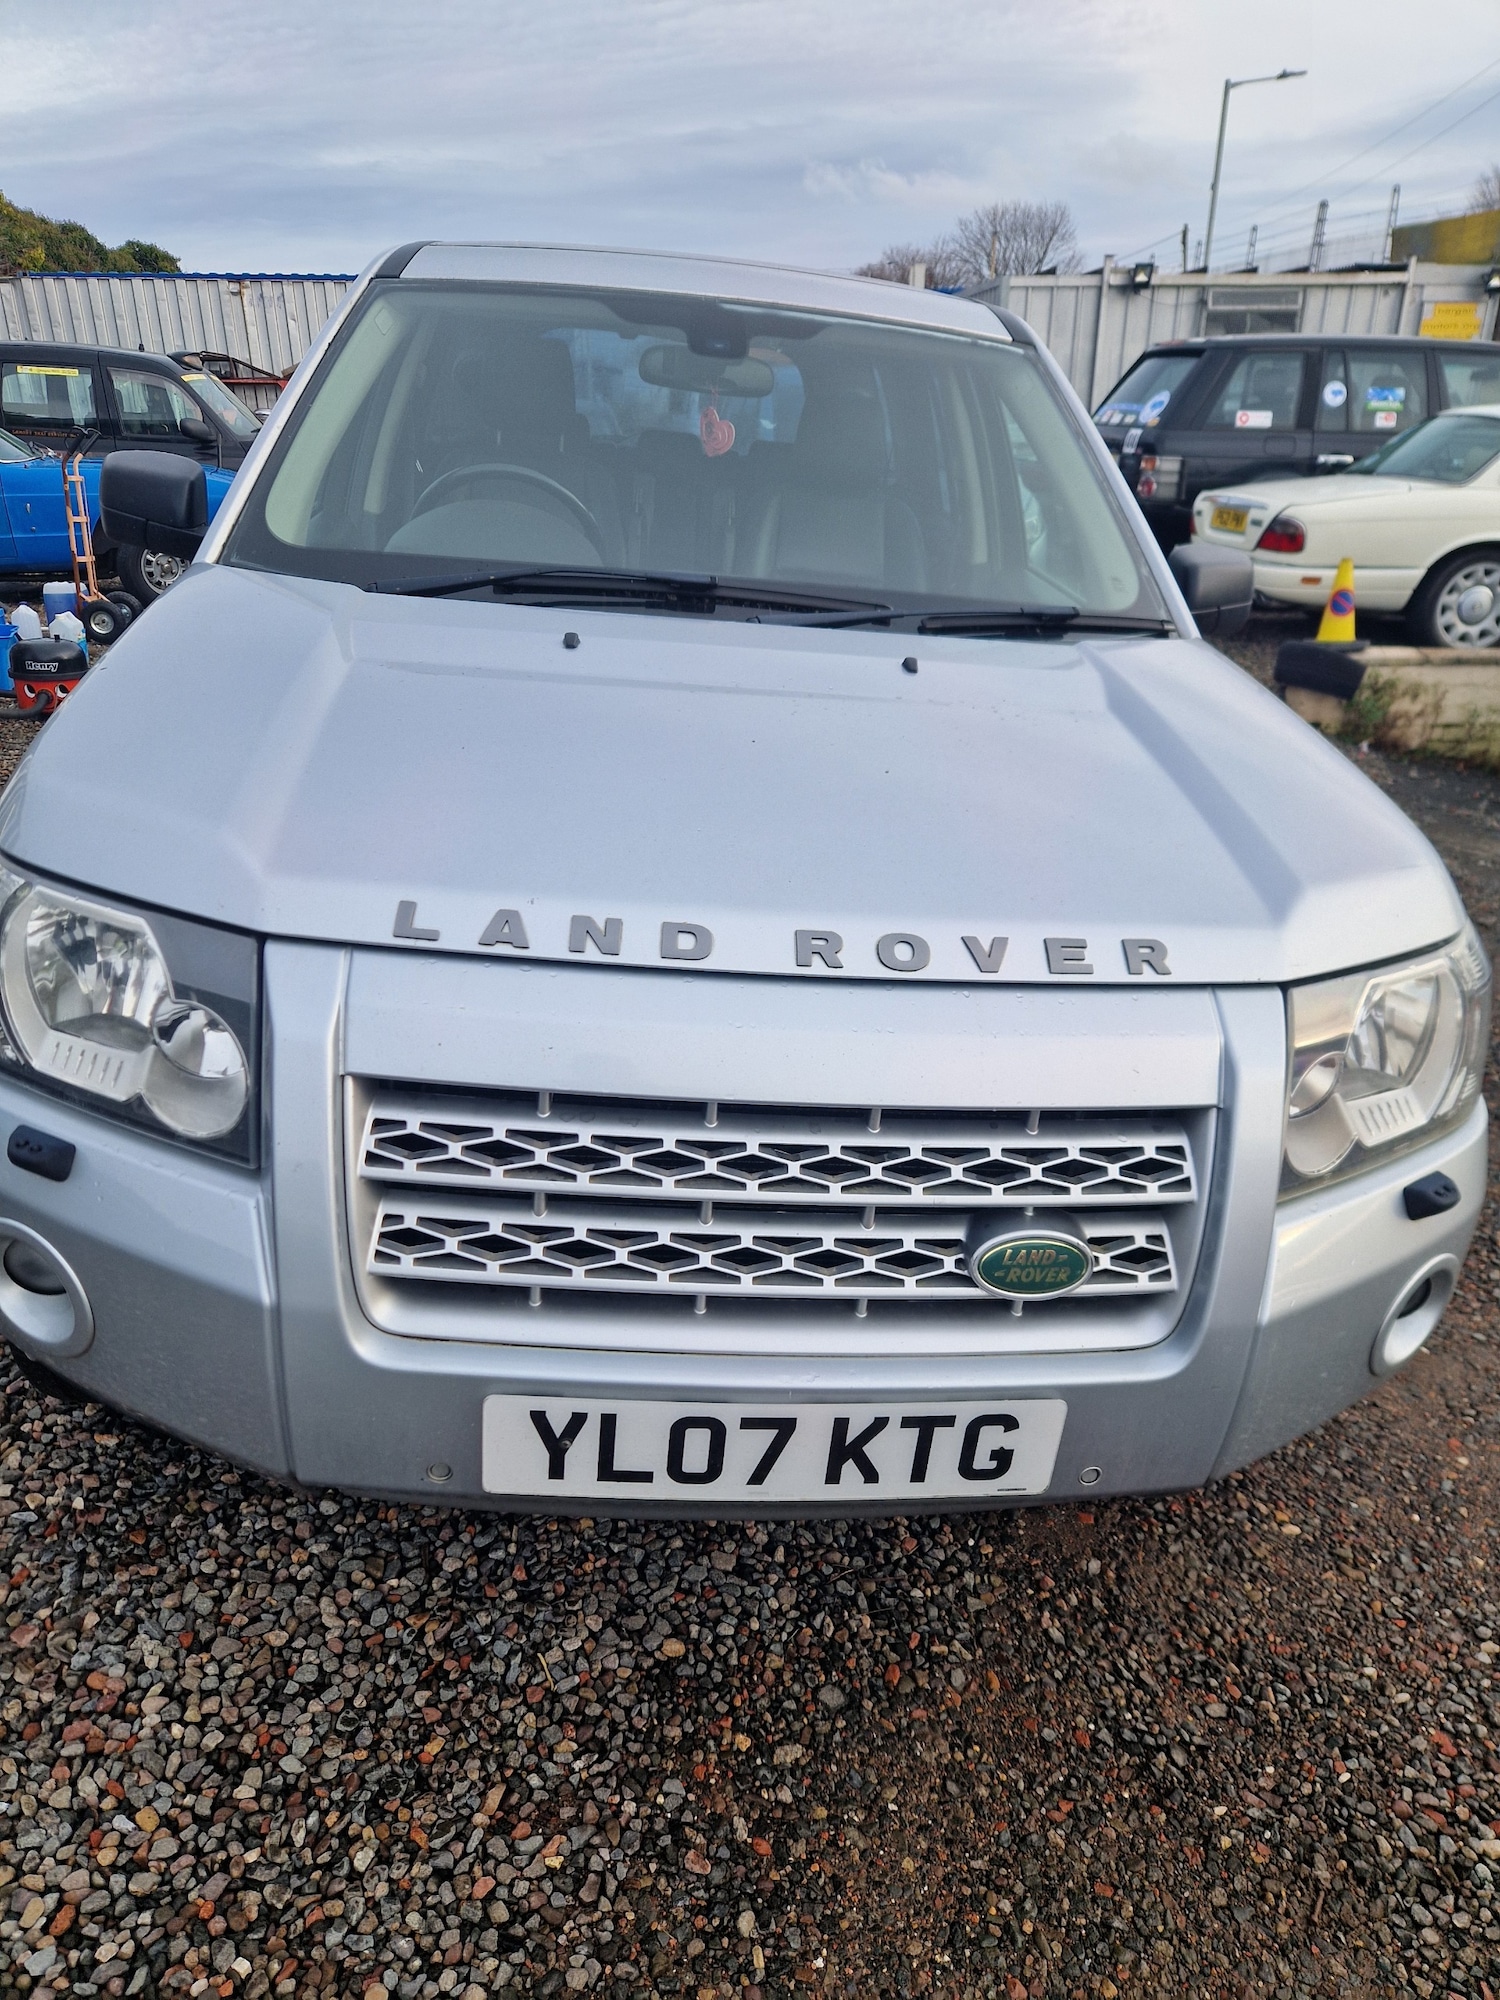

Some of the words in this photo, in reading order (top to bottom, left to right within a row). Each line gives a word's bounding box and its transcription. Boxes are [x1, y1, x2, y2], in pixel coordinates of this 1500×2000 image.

[25, 661, 59, 672] Henry
[393, 900, 714, 960] LAND
[794, 929, 1172, 975] ROVER
[1002, 1249, 1057, 1266] LAND
[1005, 1266, 1072, 1283] ROVER
[529, 1409, 798, 1486] YL07
[824, 1412, 1020, 1485] KTG
